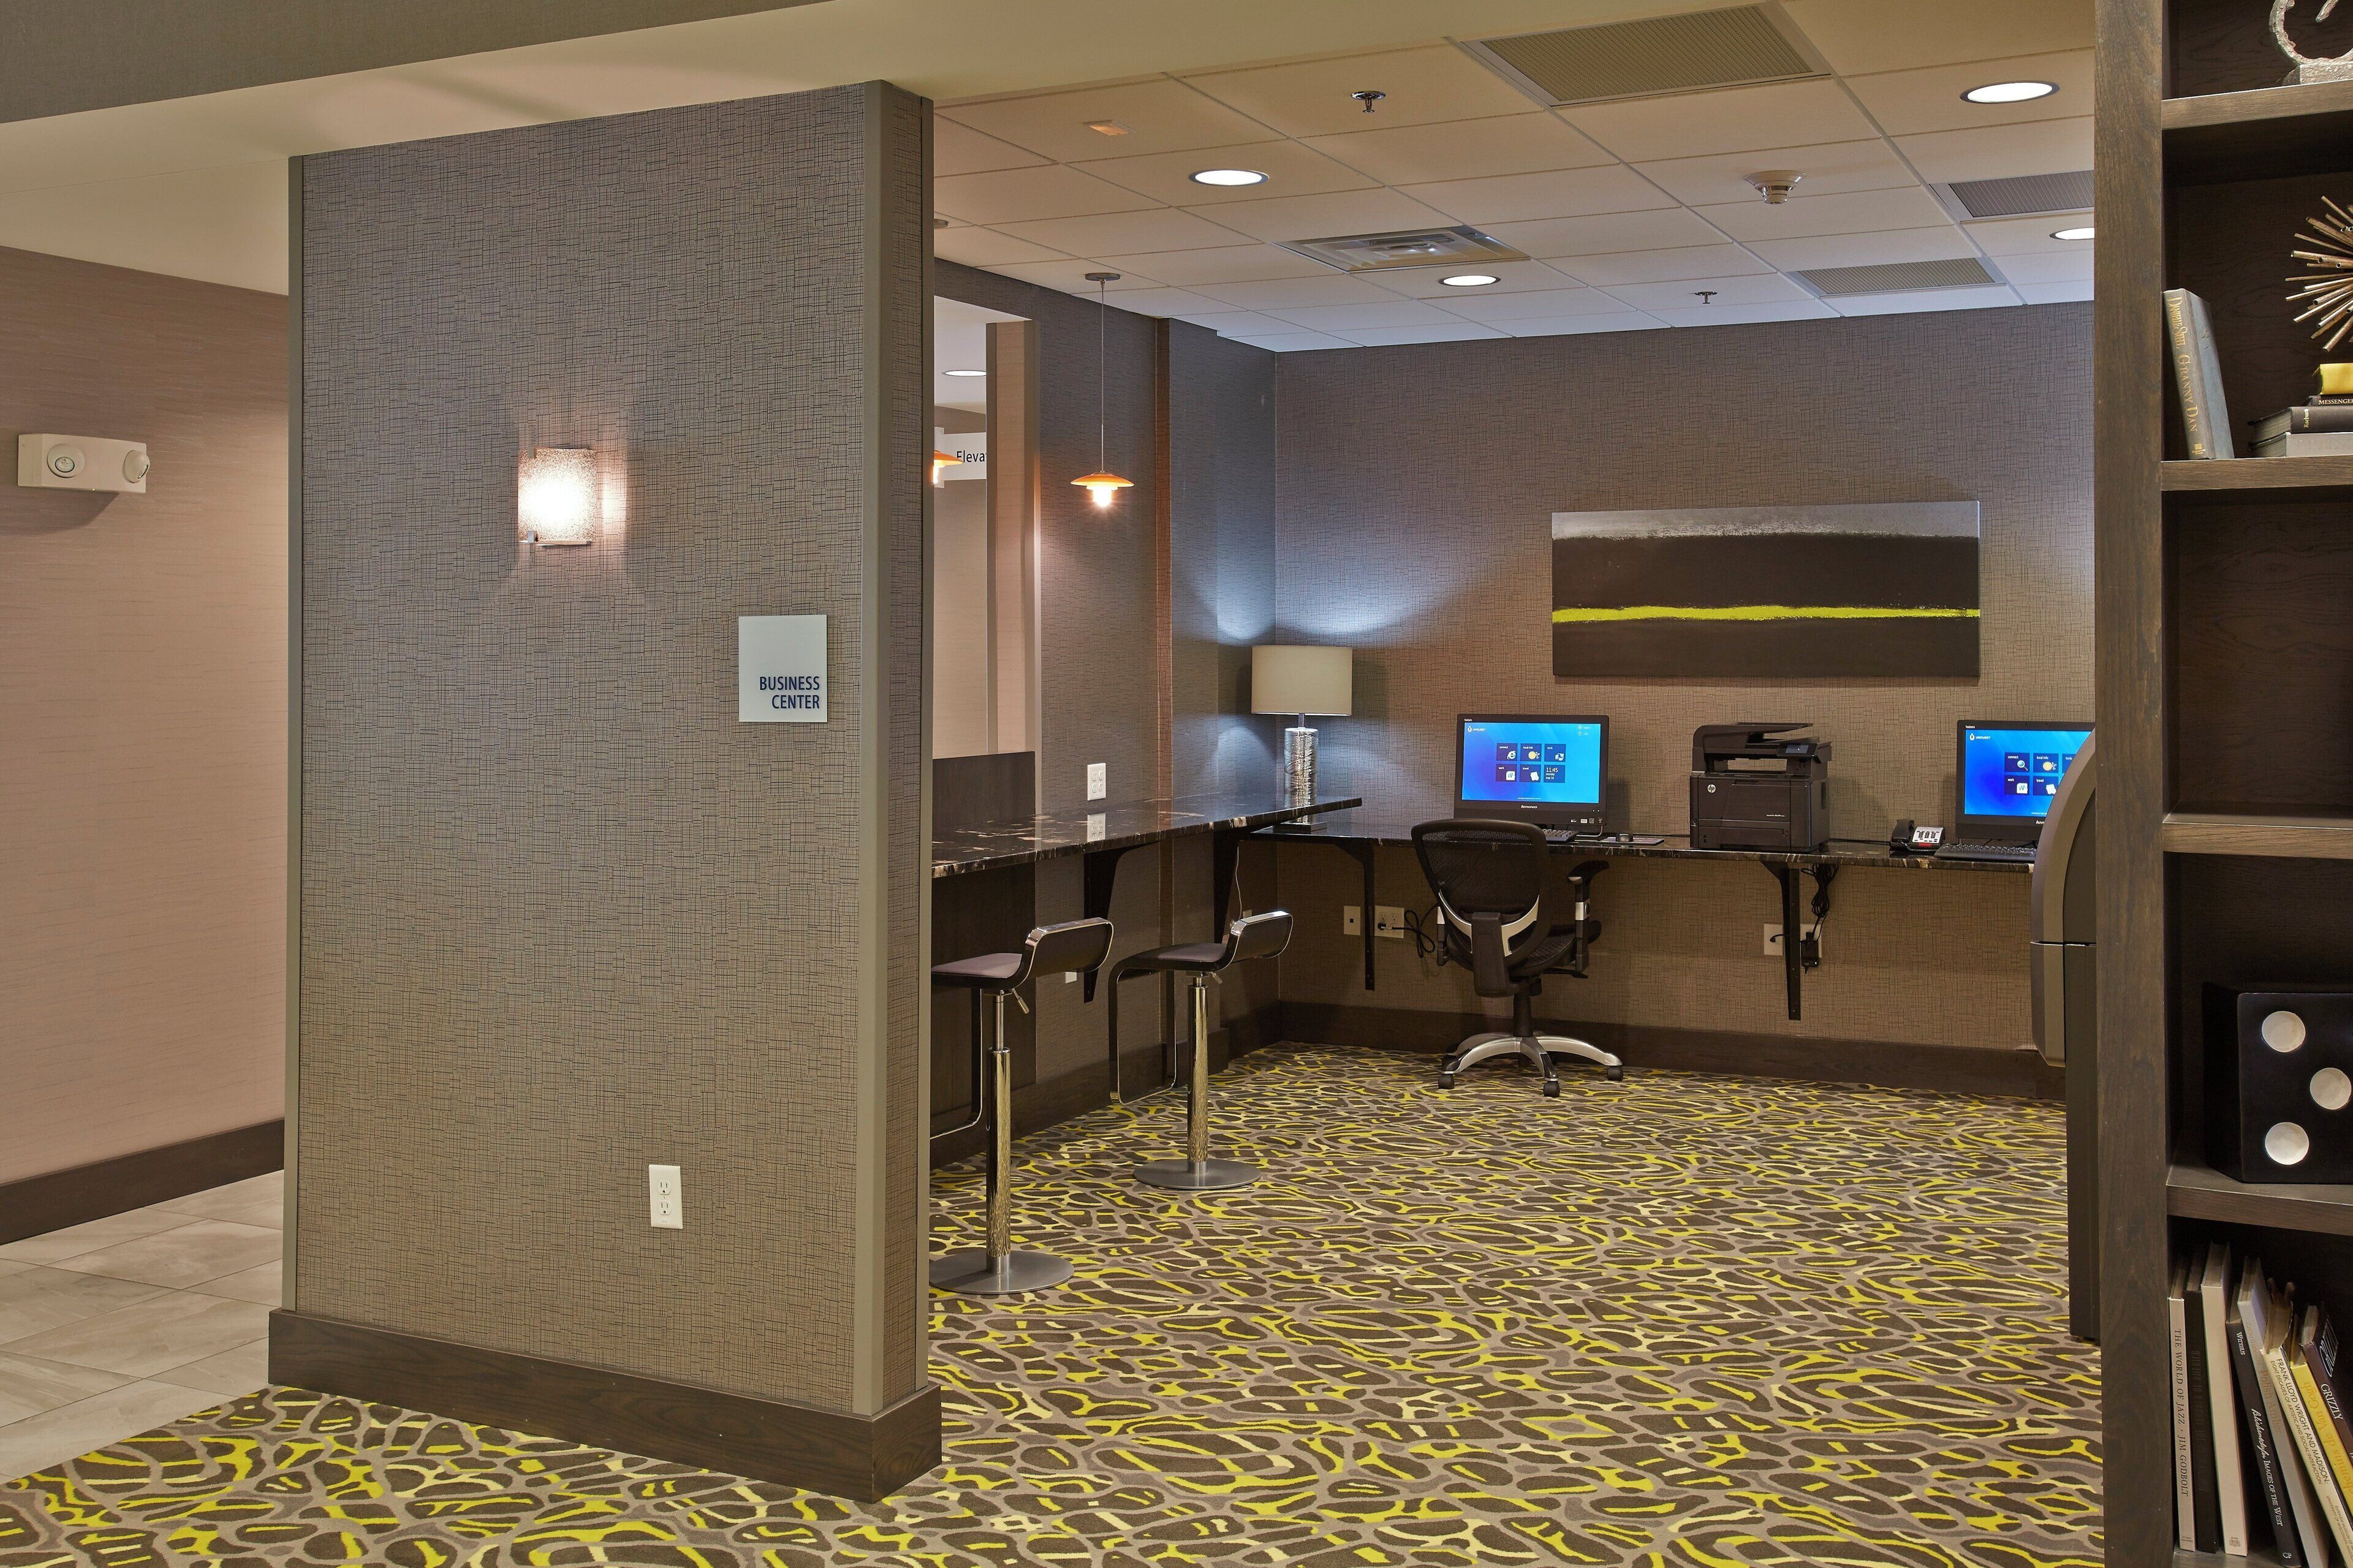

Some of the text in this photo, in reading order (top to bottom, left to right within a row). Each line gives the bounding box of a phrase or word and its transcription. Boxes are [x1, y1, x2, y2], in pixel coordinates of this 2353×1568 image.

[2178, 354, 2199, 432] GRANNY DAN
[957, 450, 987, 463] Eleva
[760, 676, 820, 690] BUSINESS
[771, 694, 820, 708] CENTER
[2177, 1388, 2184, 1400] OF
[2301, 1382, 2319, 1409] Gogh
[2321, 1384, 2344, 1420] GRIZZLY
[2177, 1402, 2186, 1425] JAZZ
[2270, 1360, 2279, 1376] EIGHT
[2276, 1375, 2287, 1396] DECADES
[2287, 1404, 2298, 1423] ARTISTIC
[2300, 1435, 2309, 1452] SOCIAL
[2307, 1453, 2322, 1485] INTERACTION
[2276, 1358, 2330, 1484] FRANK LLOYD WRIGHT AND MADISON:
[2316, 1411, 2327, 1431] Van
[2177, 1435, 2188, 1497] JIM GODBOLT
[2269, 1484, 2276, 1493] OF
[2274, 1507, 2283, 1526] WEST
